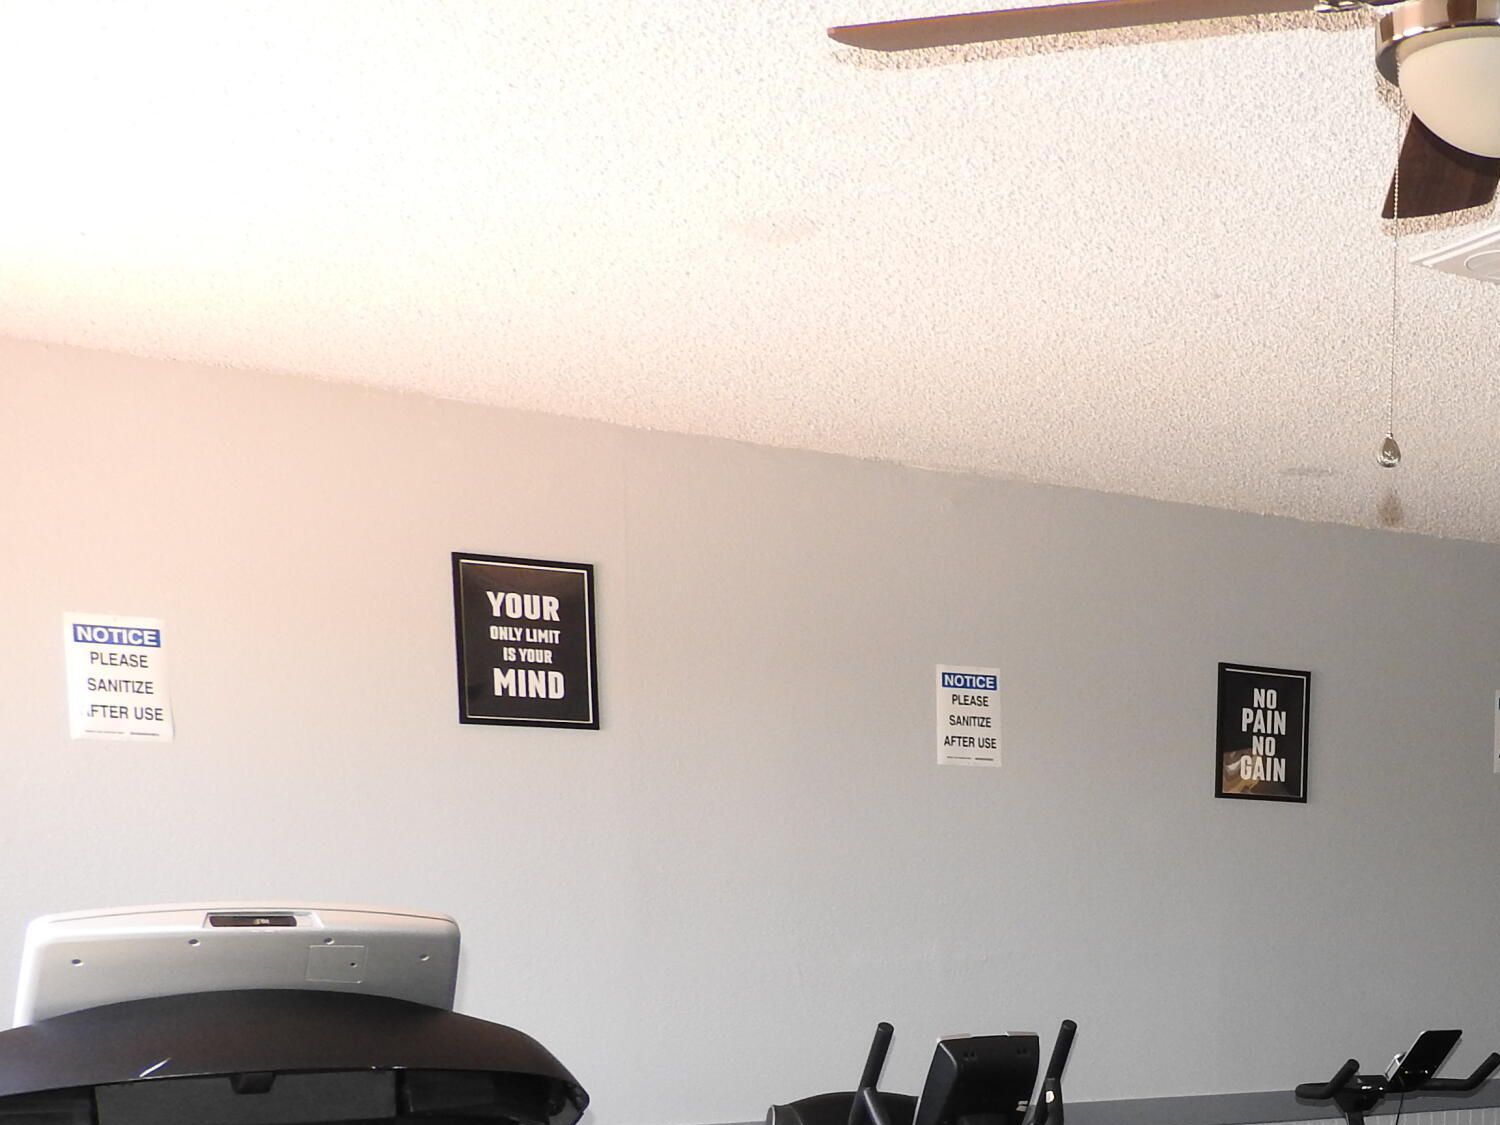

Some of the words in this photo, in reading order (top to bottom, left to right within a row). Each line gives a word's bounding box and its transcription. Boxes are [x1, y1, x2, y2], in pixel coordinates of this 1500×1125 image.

[486, 590, 560, 622] YOUR
[75, 625, 158, 646] NOTICE
[490, 626, 524, 643] ONLY
[526, 627, 561, 645] LIMIT
[90, 651, 149, 669] PLEASE
[503, 646, 517, 662] IS
[519, 647, 553, 665] YOUR
[87, 678, 154, 695] SANITIZE
[493, 667, 565, 700] MIND
[943, 674, 996, 690] NOTICE
[952, 695, 989, 708] PLEASE
[1253, 688, 1277, 709] NO
[86, 704, 129, 719] FTER
[134, 707, 164, 721] USE
[949, 714, 992, 729] SANITIZE
[1241, 708, 1286, 735] PAIN
[944, 735, 975, 748] AFTER
[977, 737, 997, 750] USE
[1252, 736, 1276, 757] NO
[1240, 756, 1286, 783] GAIN
